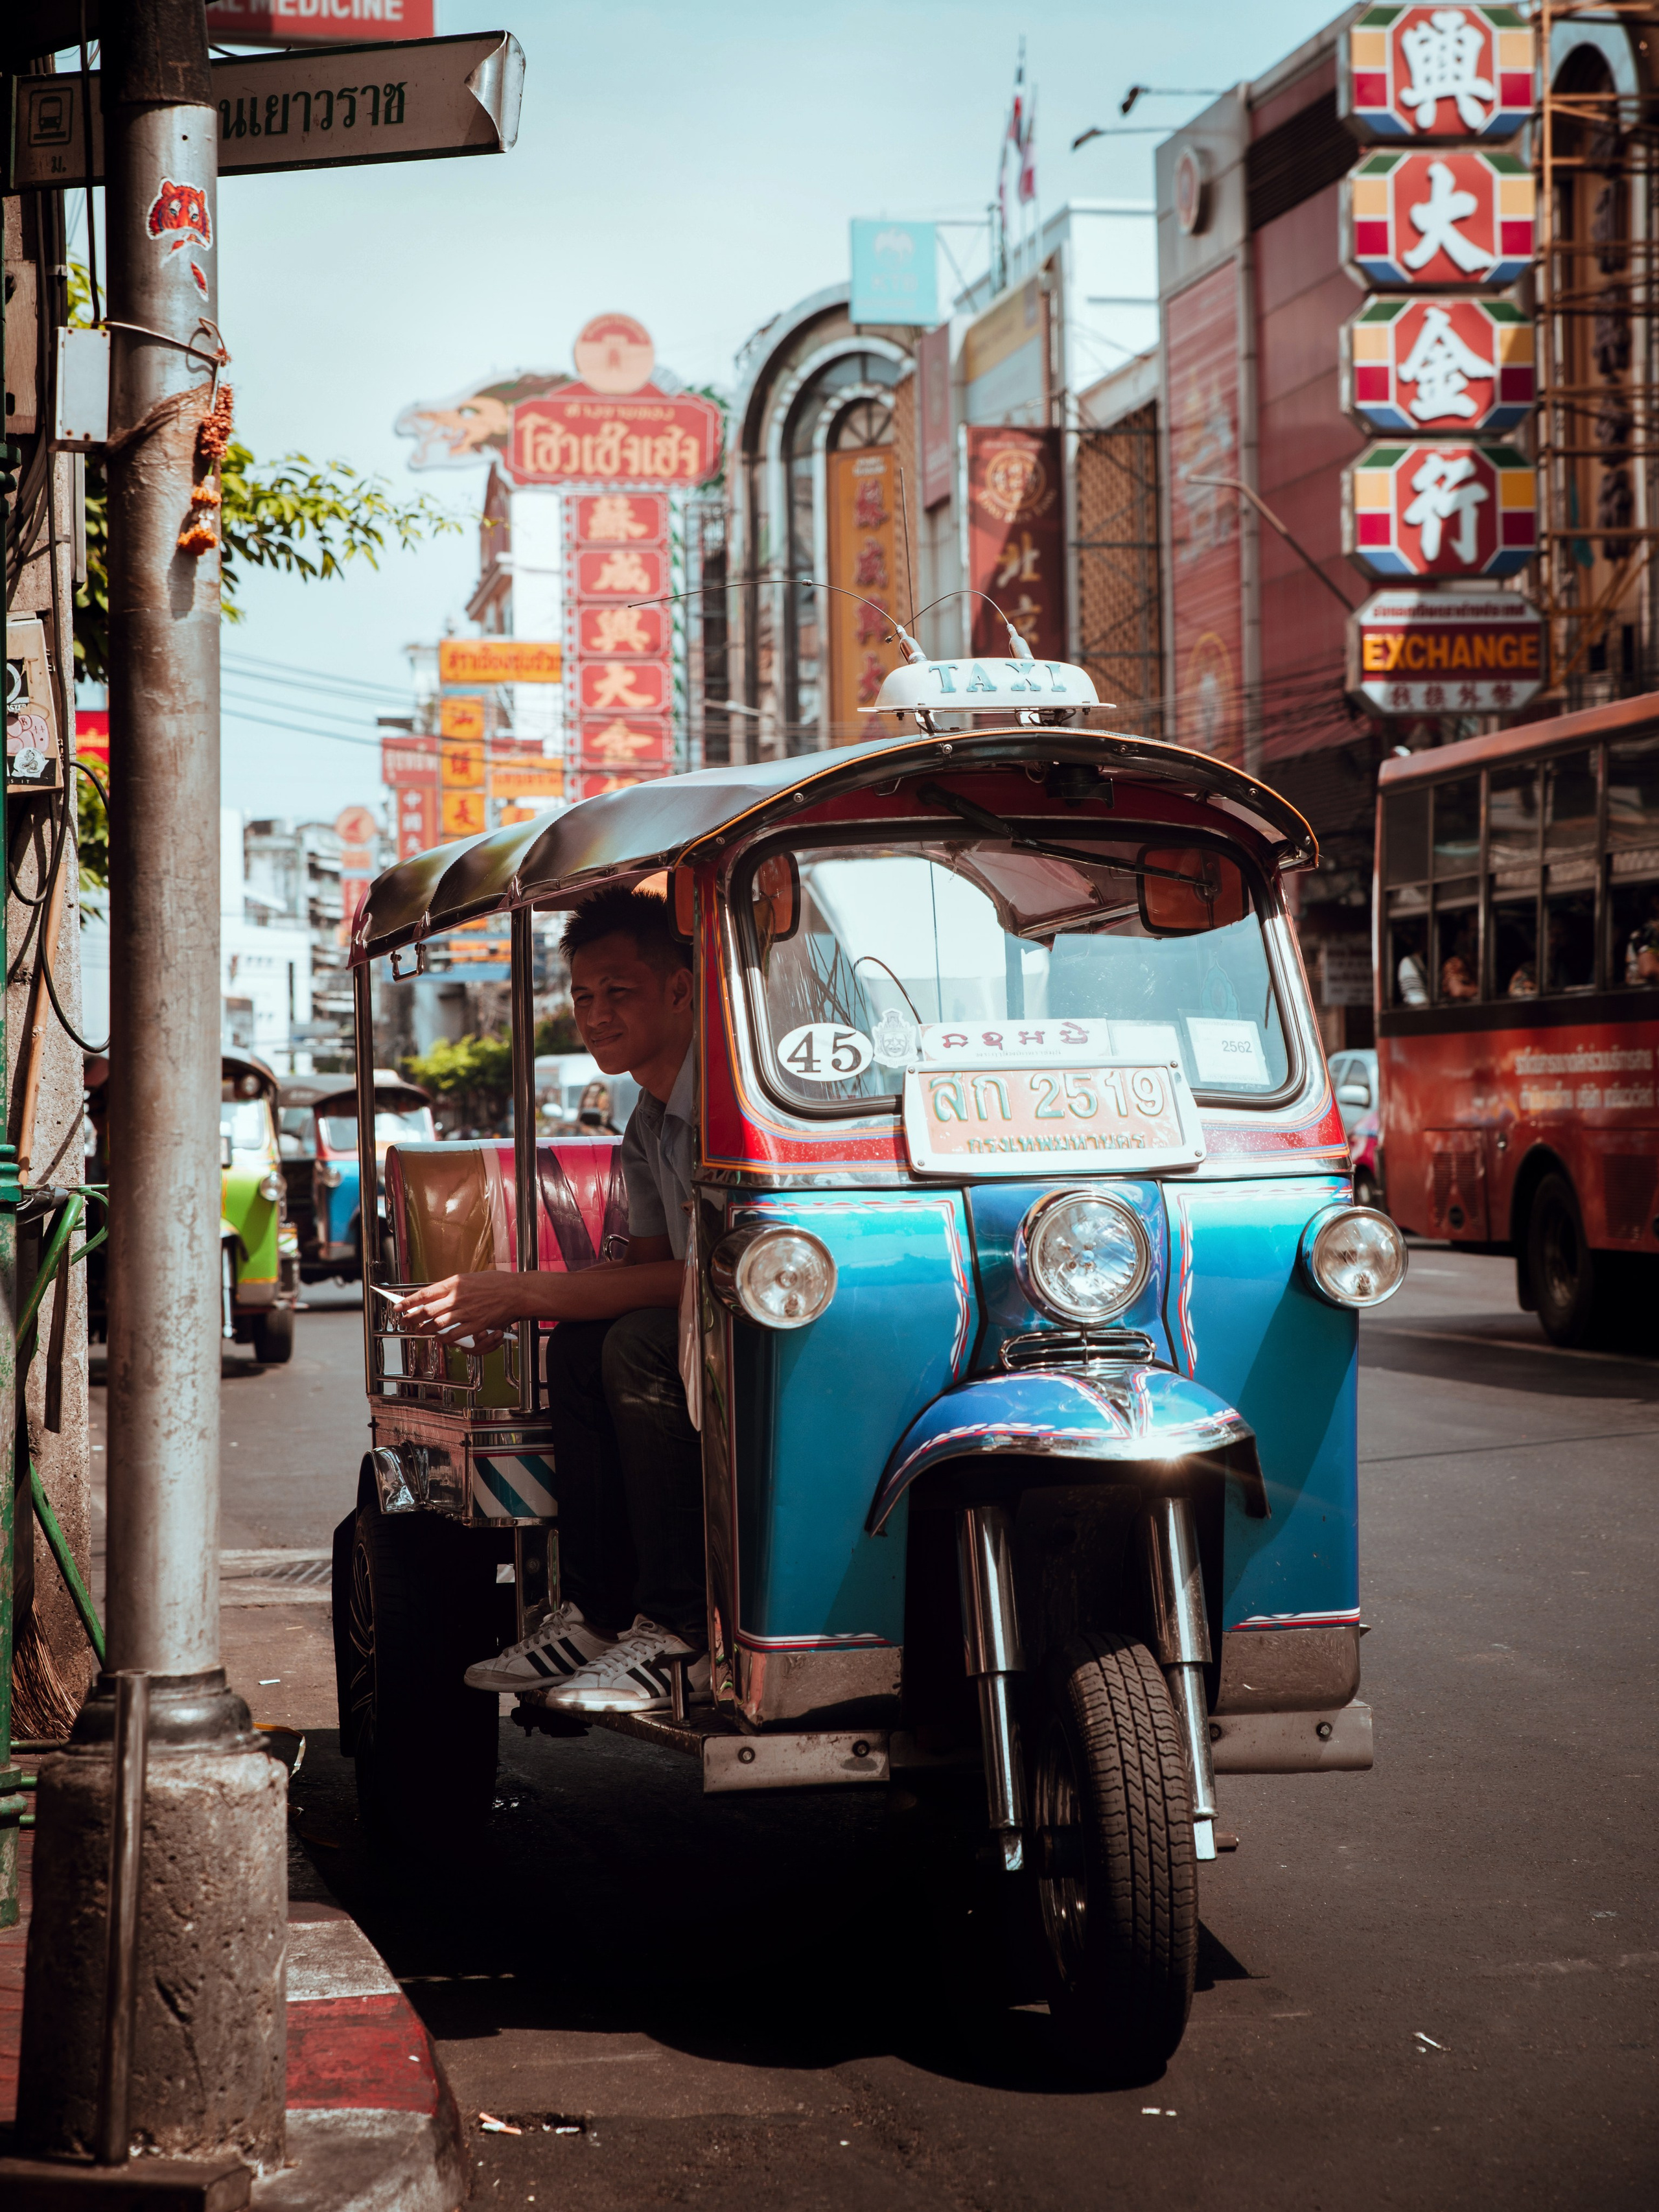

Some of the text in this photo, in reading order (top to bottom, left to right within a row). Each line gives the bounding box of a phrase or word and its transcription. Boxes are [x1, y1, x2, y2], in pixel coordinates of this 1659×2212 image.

[251, 0, 404, 21] MEDICINE
[219, 82, 408, 139] นเยาวราช
[1363, 633, 1539, 671] EXCHANGE
[929, 662, 1067, 693] TAXI
[787, 1030, 862, 1073] 45
[1222, 1040, 1252, 1053] 2562
[1030, 1069, 1165, 1119] 2519
[968, 1133, 1146, 1154] กรงเทพมหานคร
